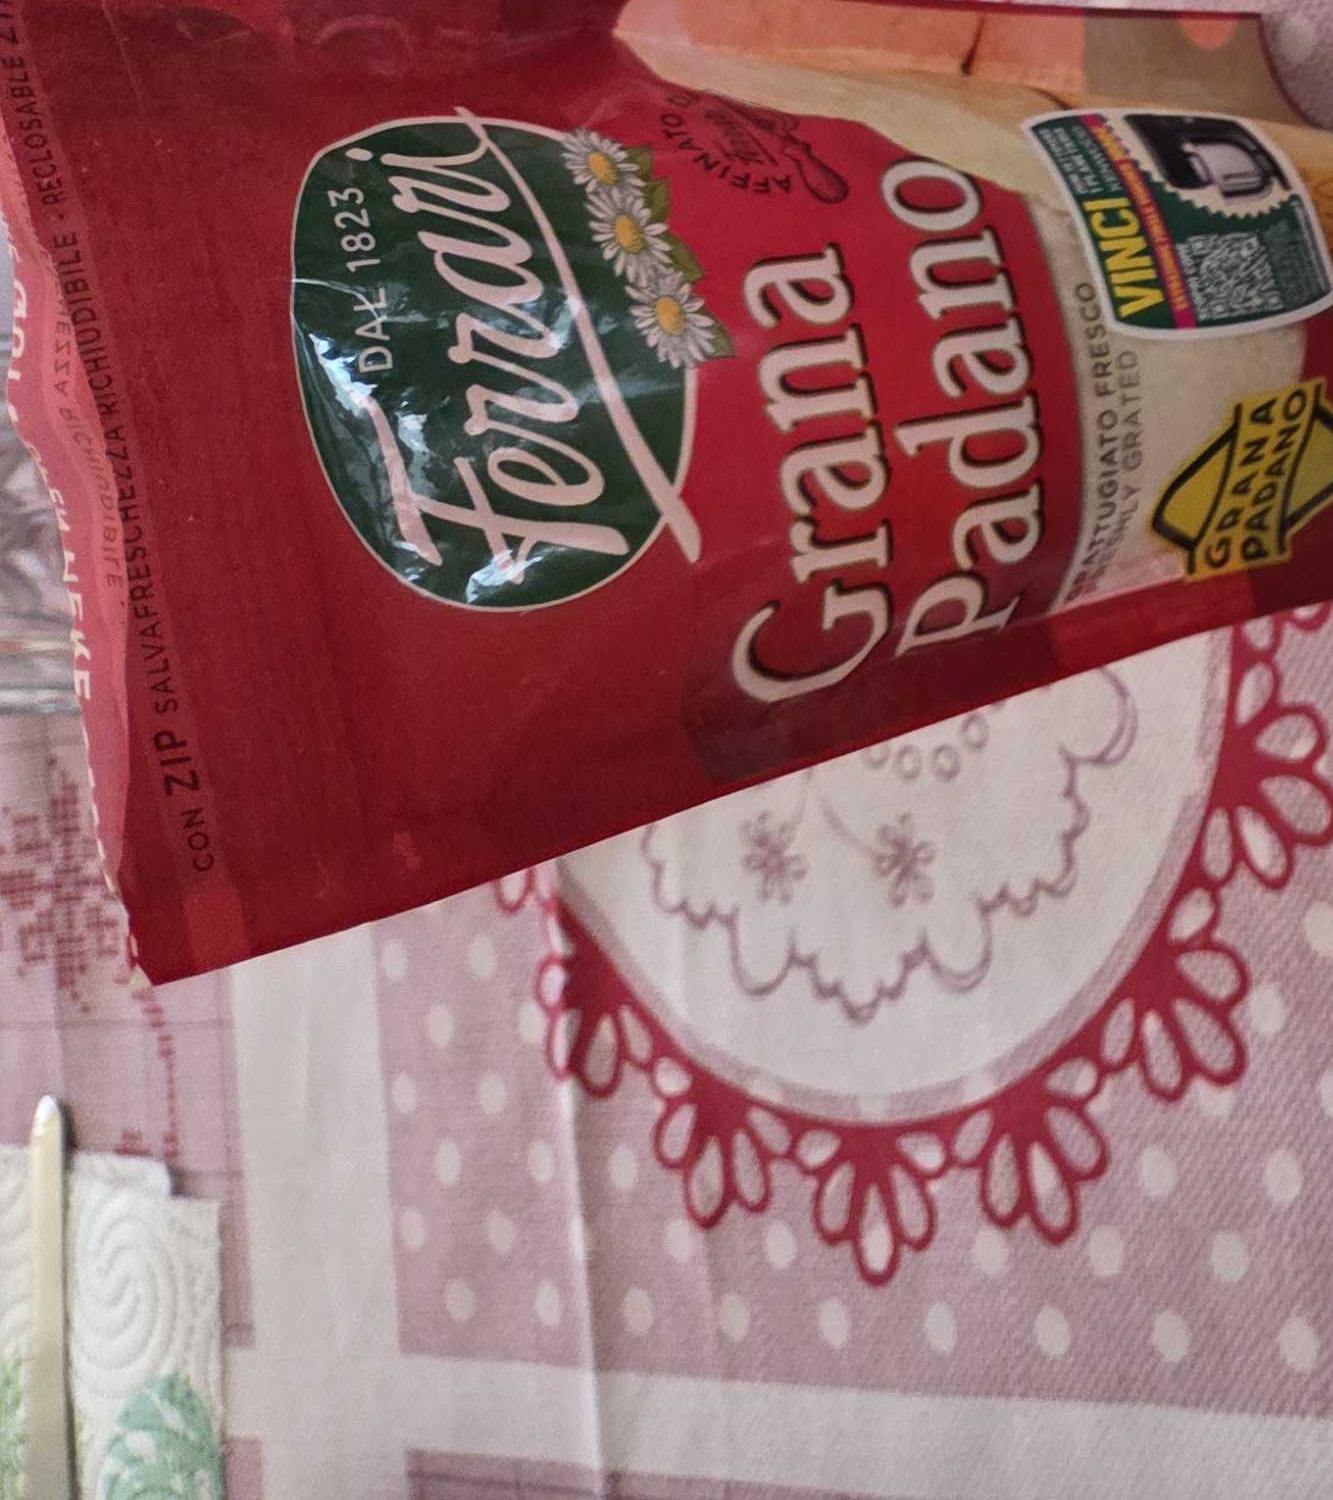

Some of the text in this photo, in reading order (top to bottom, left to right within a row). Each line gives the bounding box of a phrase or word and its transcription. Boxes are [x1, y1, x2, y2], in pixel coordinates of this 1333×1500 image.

[2, 55, 66, 205] RECLOSABLE
[660, 112, 791, 193] AFFINATO
[51, 231, 119, 415] RICHIUDIBILE
[328, 185, 393, 371] DAL 1823
[1075, 280, 1114, 396] FRESCO
[1081, 195, 1164, 317] VINCI
[346, 114, 635, 583] Ferrari
[880, 158, 1042, 656] Padano
[1116, 349, 1143, 471] GRATED
[731, 243, 891, 702] Grana
[1205, 397, 1277, 569] GRANA
[1239, 386, 1307, 561] PADANO
[104, 425, 179, 713] SALVAFRESCHEZZA
[154, 728, 201, 795] ZIP
[182, 807, 215, 872] CON
